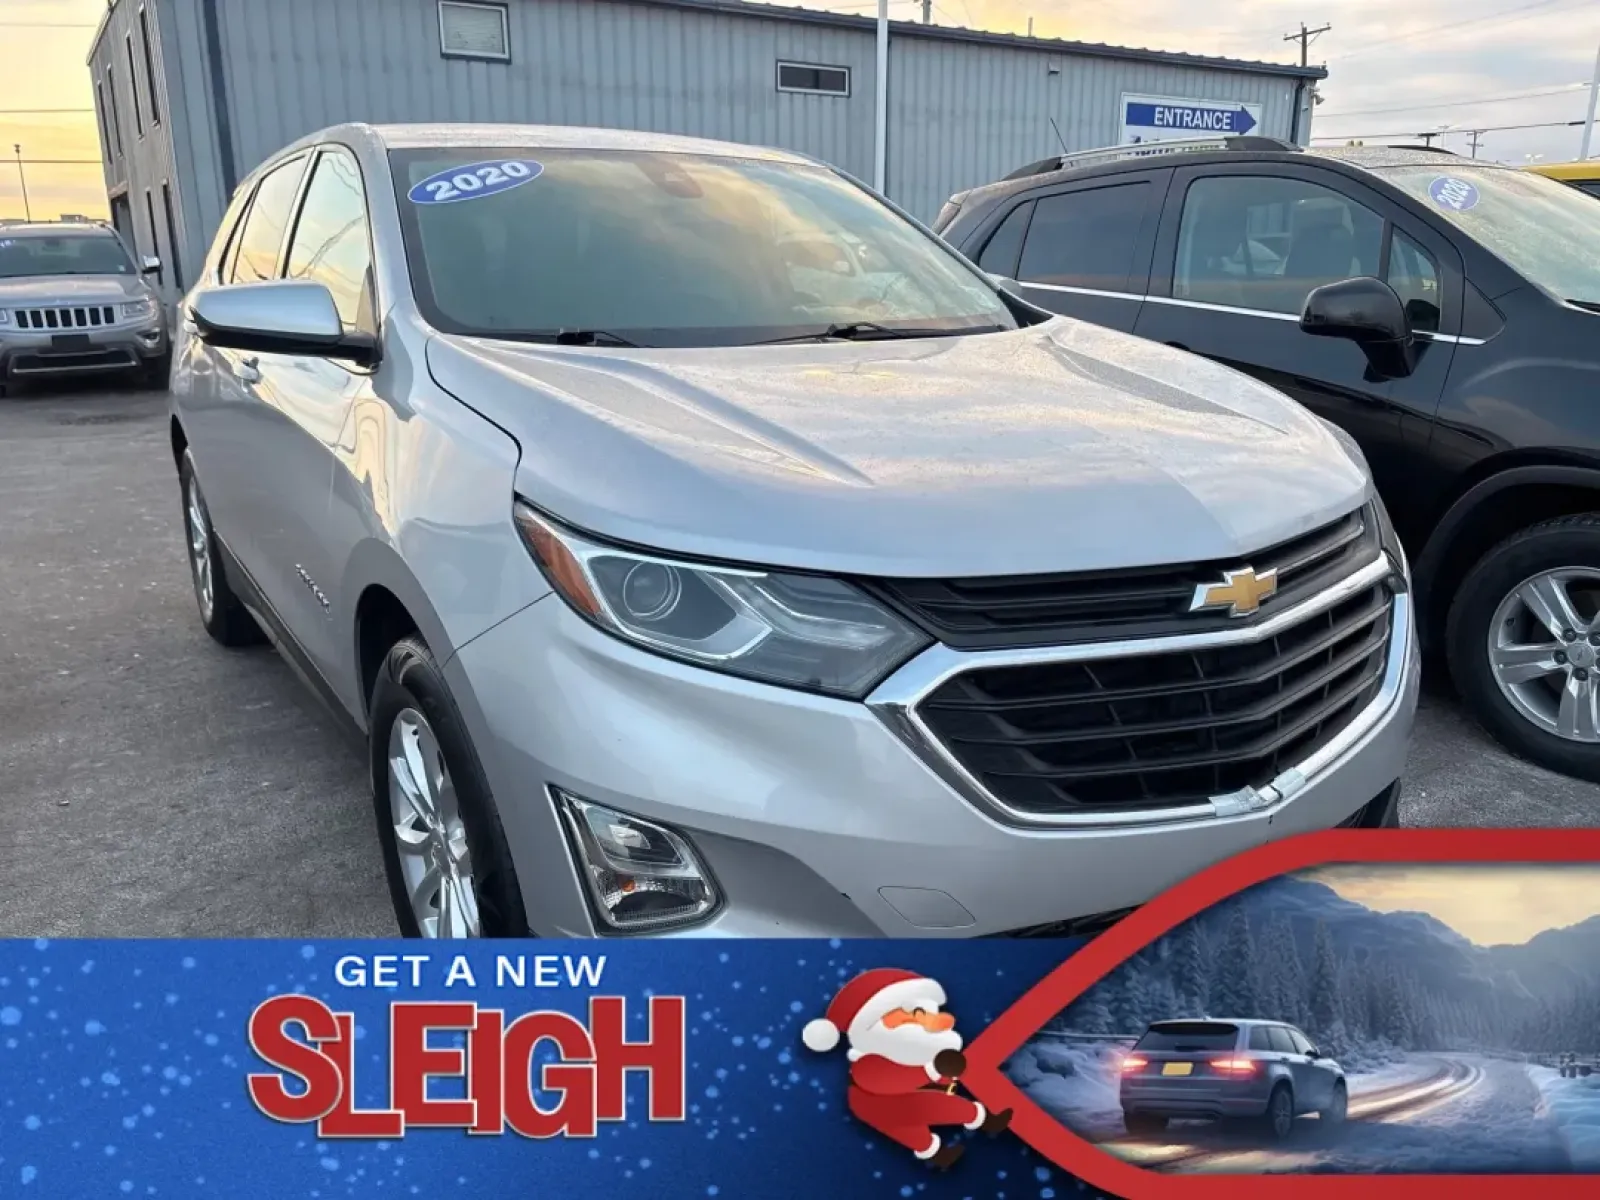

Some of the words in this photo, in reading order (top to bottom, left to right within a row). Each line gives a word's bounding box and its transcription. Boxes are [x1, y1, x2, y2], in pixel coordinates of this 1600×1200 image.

[1153, 106, 1232, 130] ENTRANCE
[425, 160, 532, 201] 2020
[1436, 178, 1471, 210] 2020
